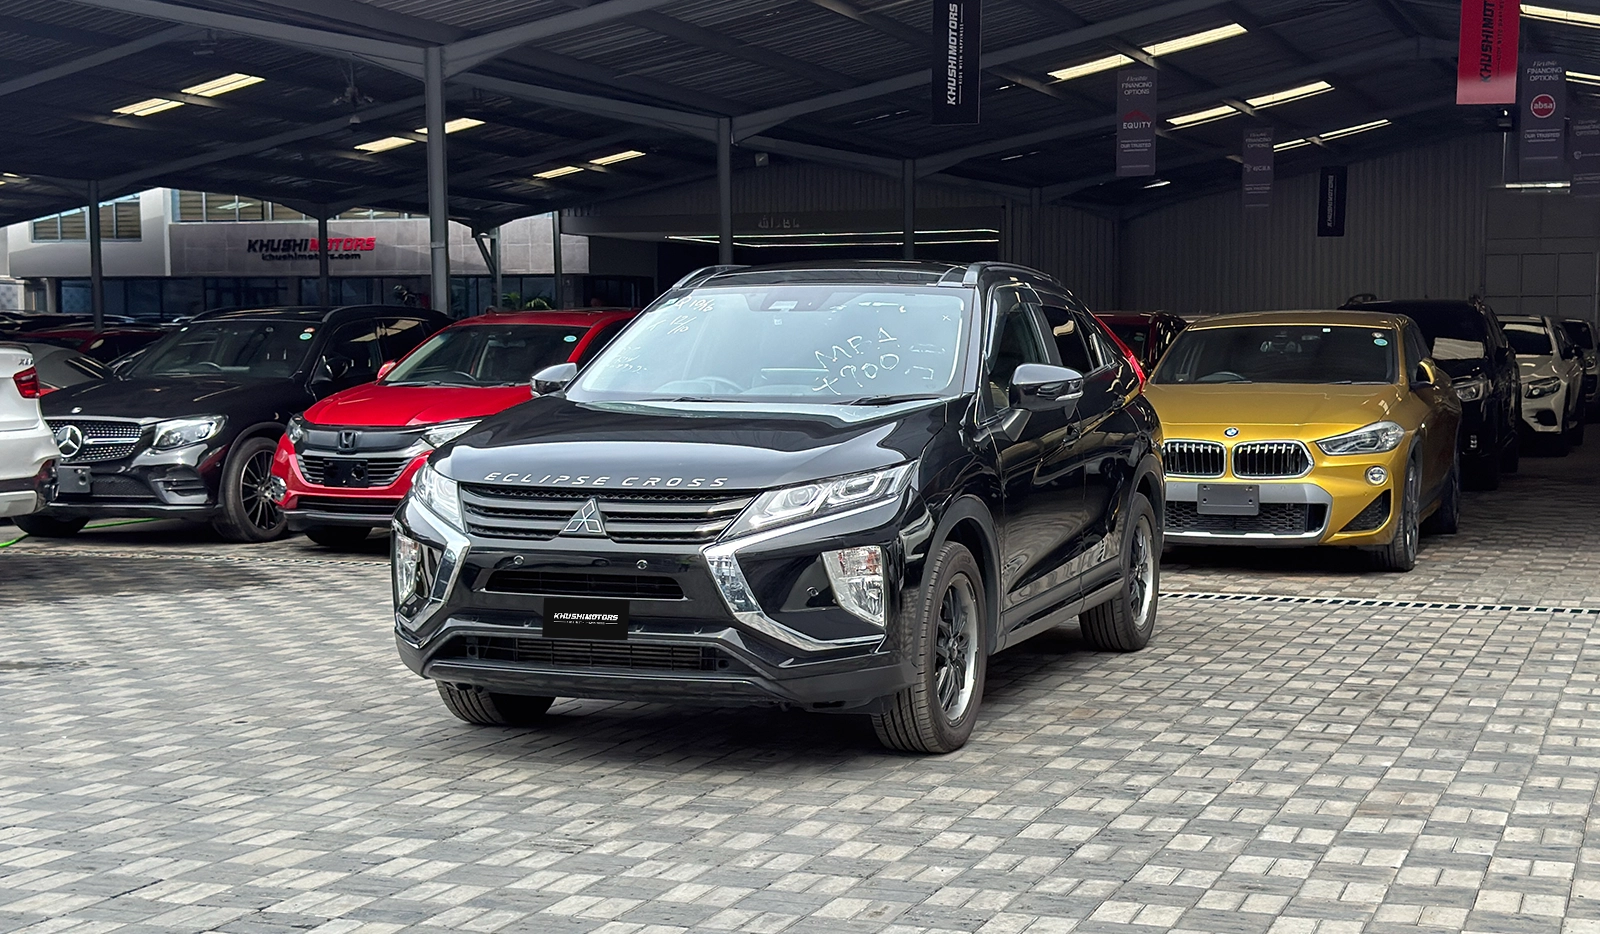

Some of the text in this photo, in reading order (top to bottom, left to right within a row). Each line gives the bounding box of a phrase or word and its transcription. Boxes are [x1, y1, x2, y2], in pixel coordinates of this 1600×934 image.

[947, 3, 958, 105] KHUSHIMOTORS
[1529, 74, 1559, 82] OPTIONS
[1533, 101, 1553, 110] absa
[1122, 121, 1152, 130] EQUITY
[484, 472, 728, 487] ECLIPSE CROSS
[553, 612, 619, 621] KHUSHIMOTORS
